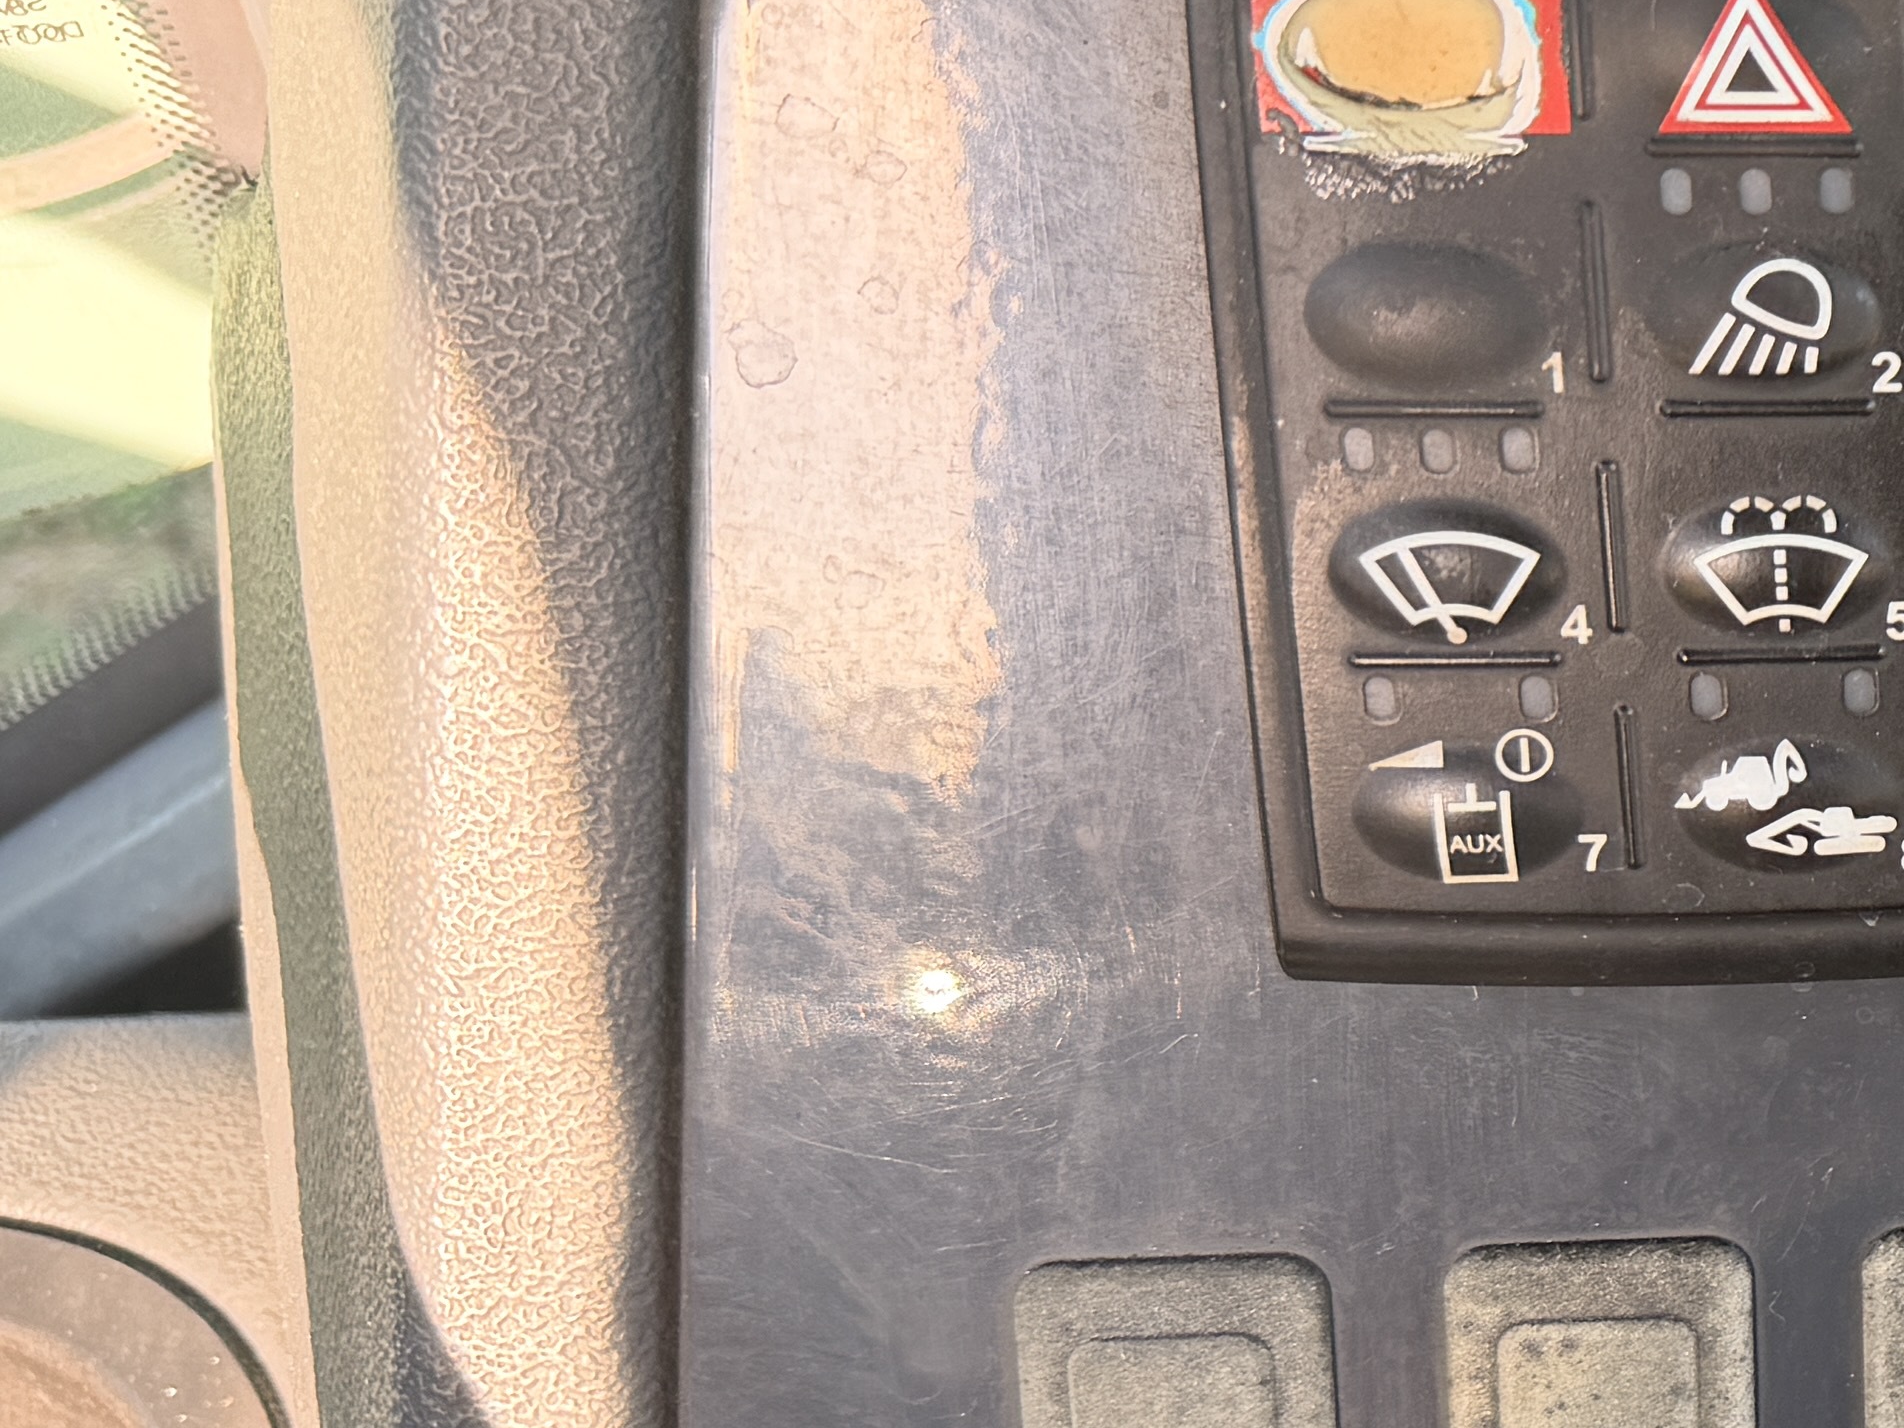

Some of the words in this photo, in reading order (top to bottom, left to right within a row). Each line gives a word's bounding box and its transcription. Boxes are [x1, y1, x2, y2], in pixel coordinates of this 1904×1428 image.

[1541, 351, 1565, 393] 1
[1871, 351, 1903, 393] 2
[1560, 604, 1593, 645] 4
[1449, 824, 1505, 854] AUX
[1577, 833, 1608, 872] 7
